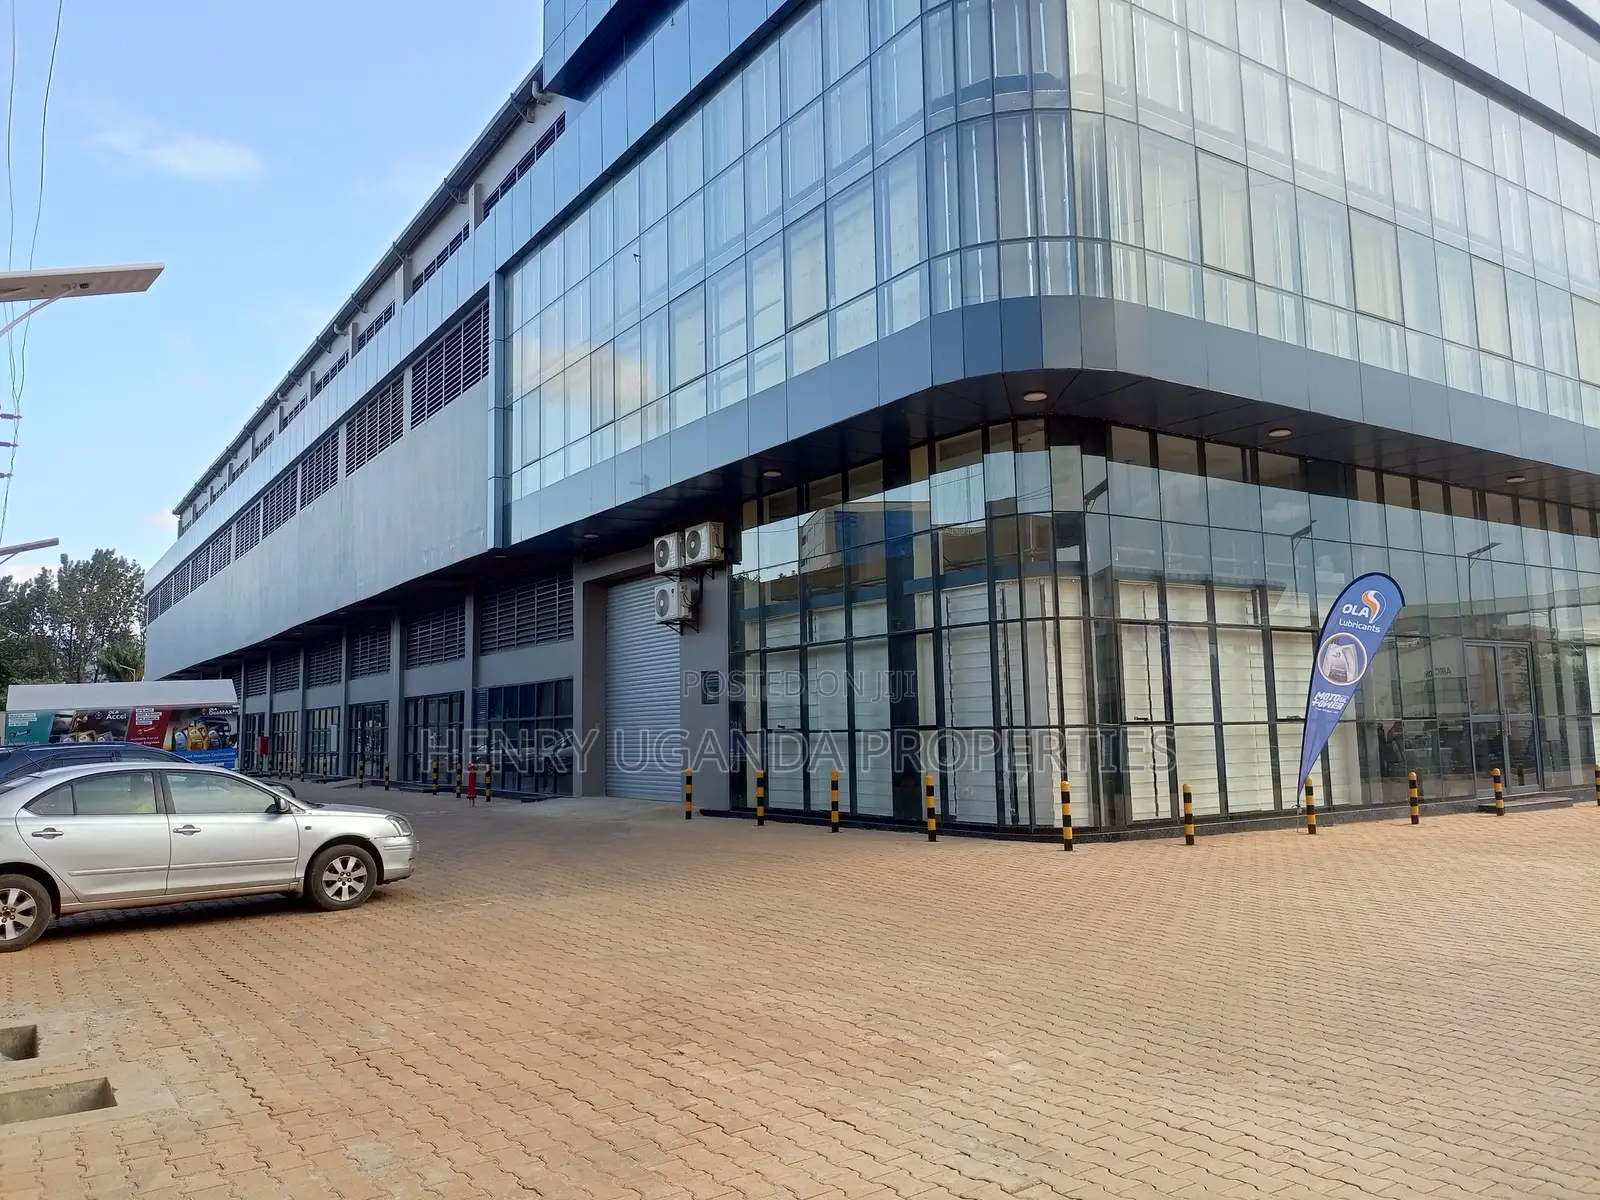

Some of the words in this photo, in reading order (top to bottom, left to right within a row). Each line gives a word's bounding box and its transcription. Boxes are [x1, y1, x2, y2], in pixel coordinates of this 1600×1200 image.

[1342, 603, 1370, 618] OLA
[1338, 618, 1381, 633] Lubricants
[1314, 691, 1341, 703] MOTO
[105, 713, 127, 721] Accel
